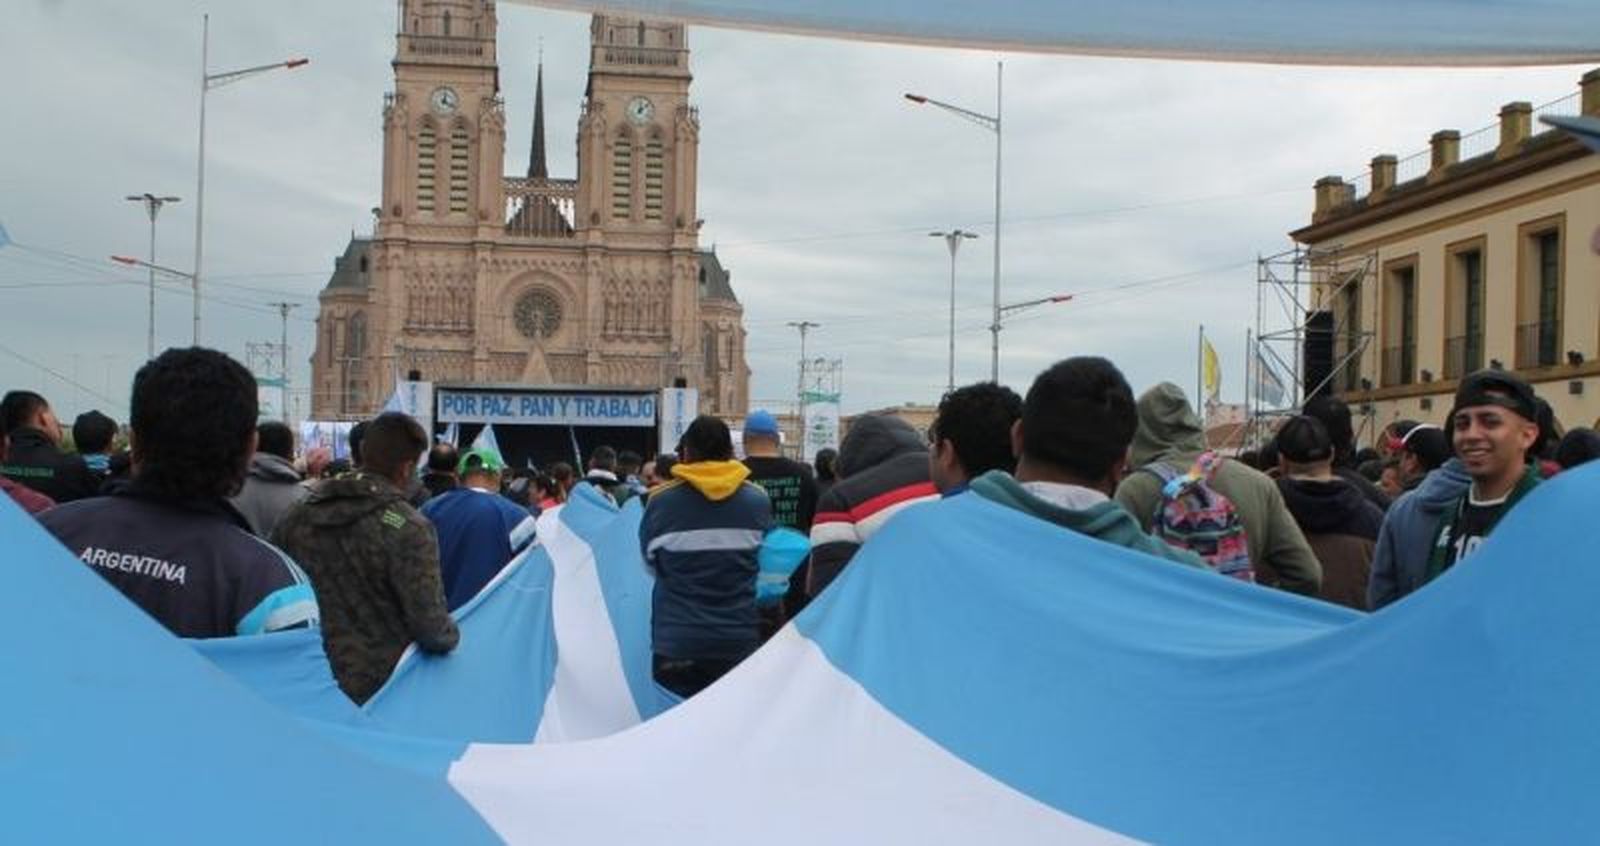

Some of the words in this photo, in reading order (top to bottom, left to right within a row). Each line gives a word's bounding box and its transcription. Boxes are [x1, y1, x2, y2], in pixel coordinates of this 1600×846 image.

[442, 395, 477, 415] POR
[520, 396, 555, 417] PAN
[558, 396, 570, 417] Y
[574, 397, 653, 418] TRABAJO
[80, 547, 187, 585] ARGENTINA
